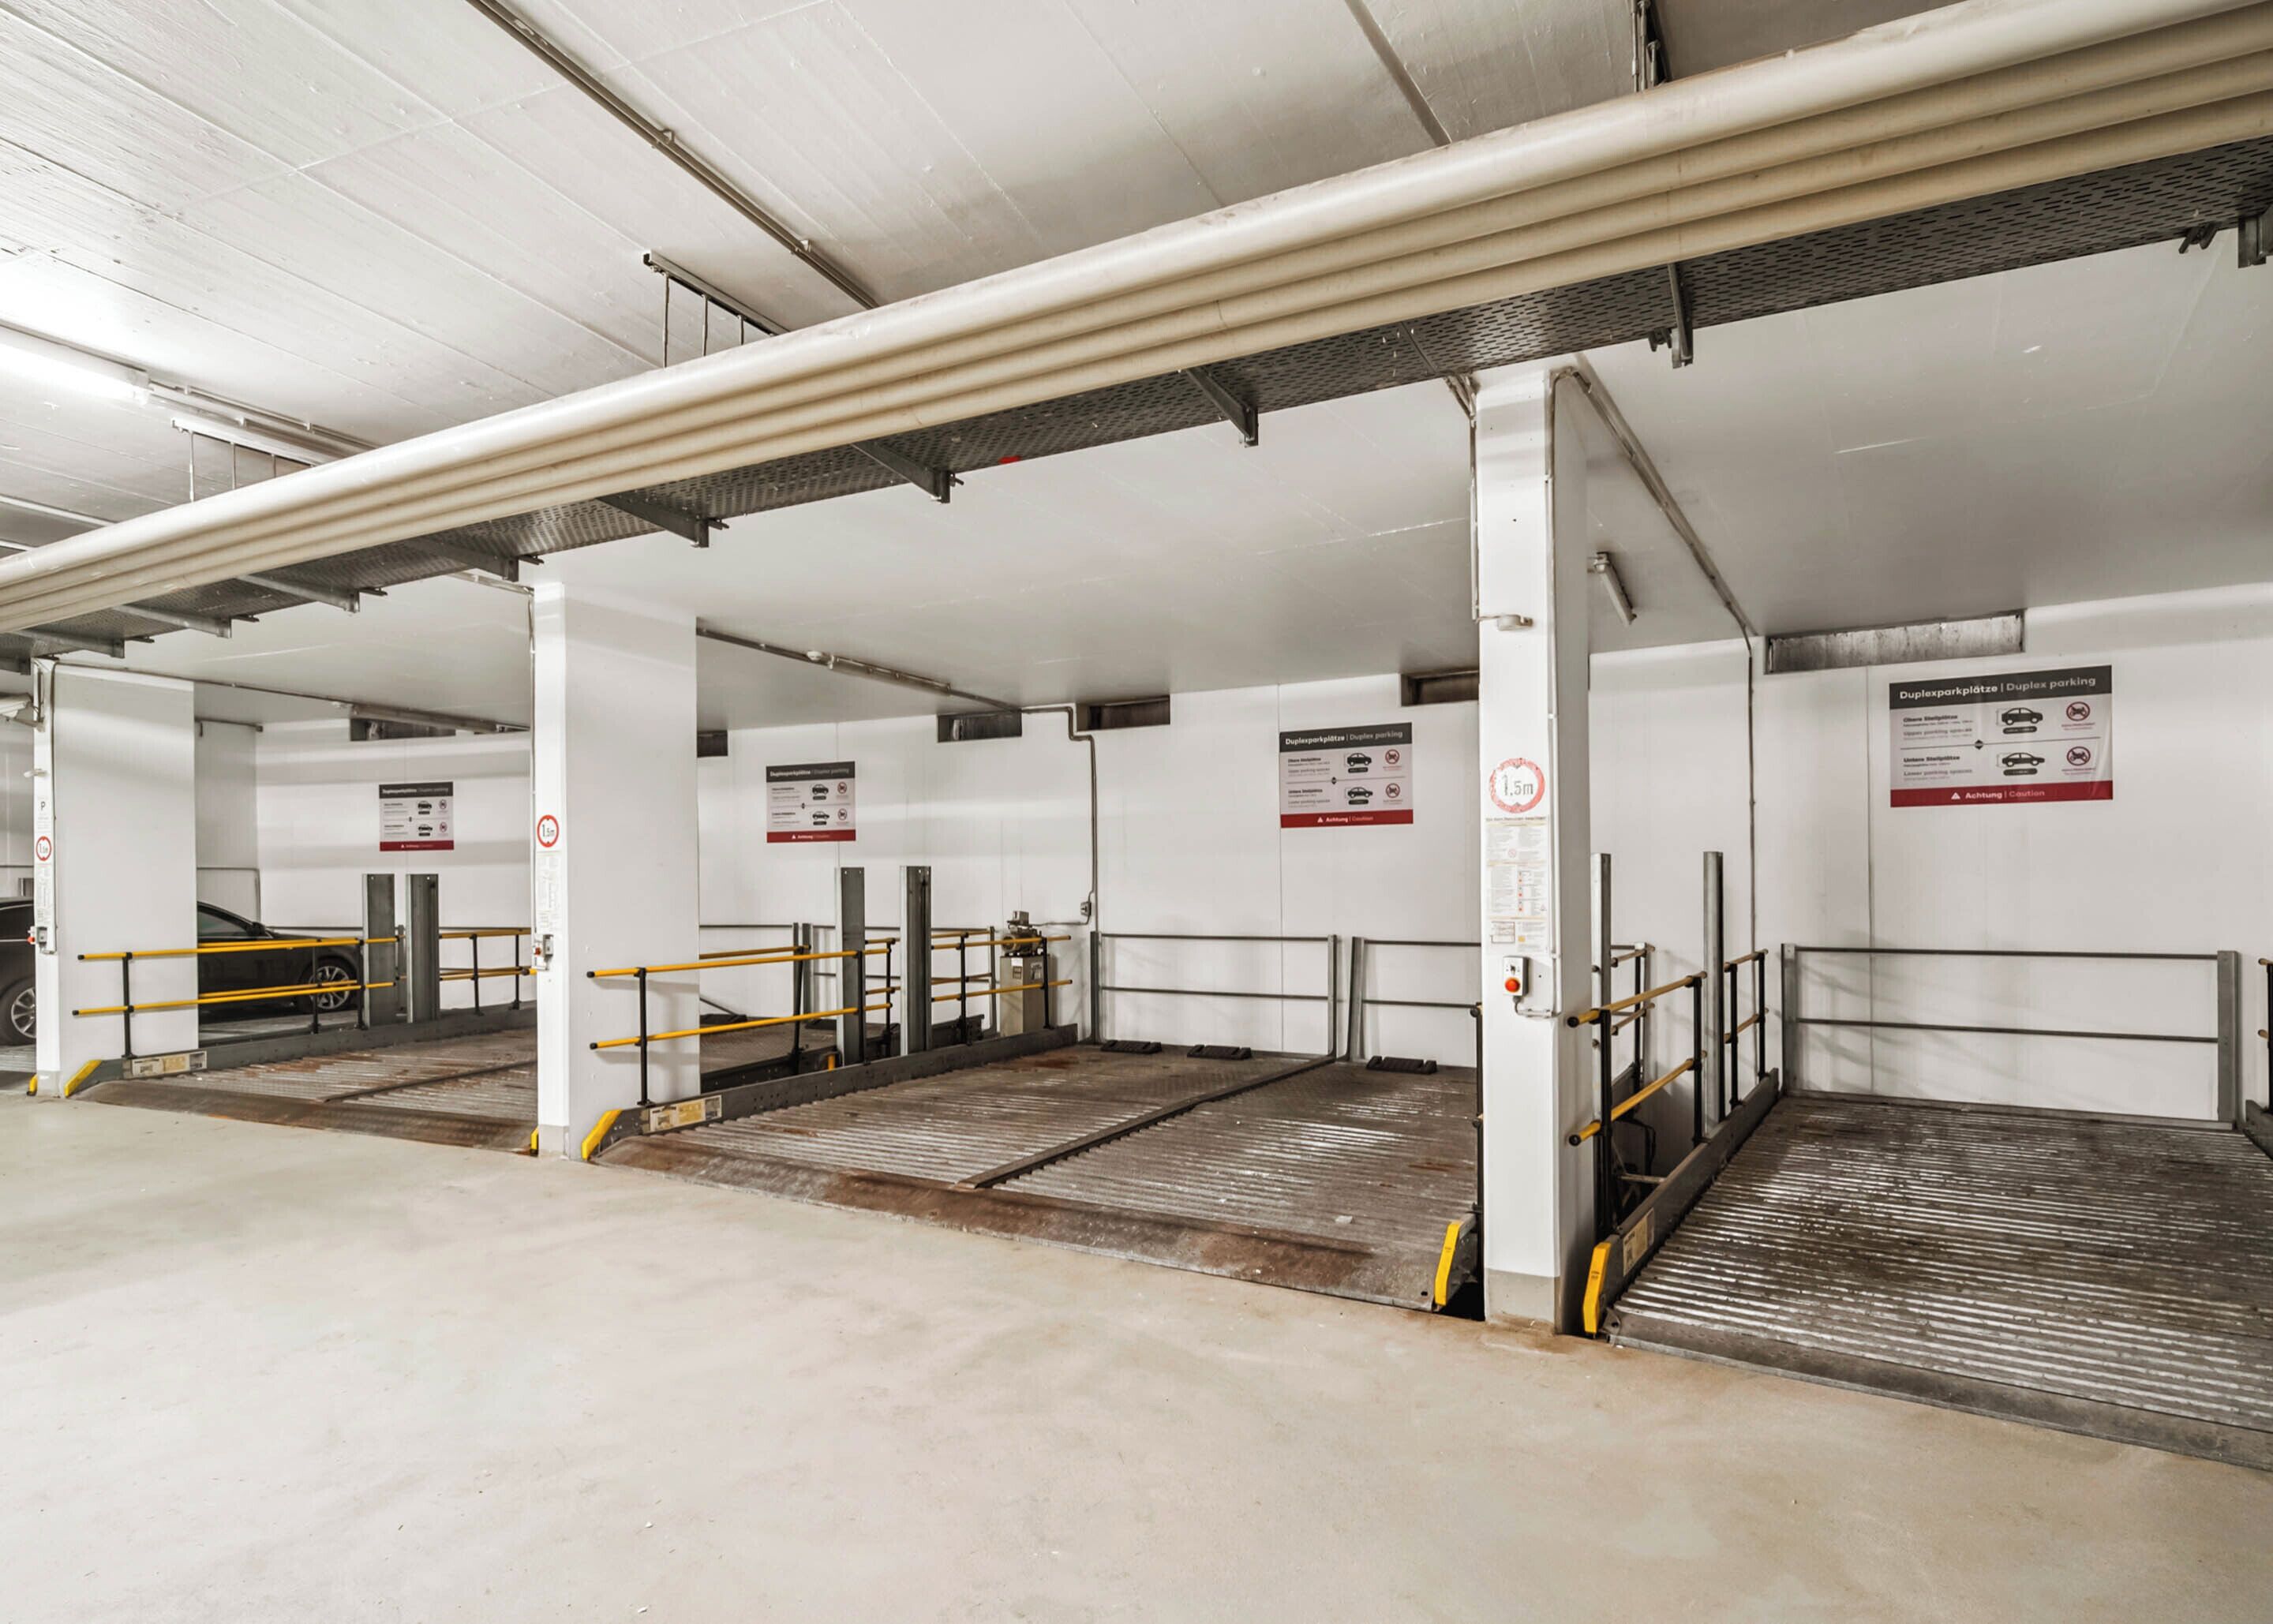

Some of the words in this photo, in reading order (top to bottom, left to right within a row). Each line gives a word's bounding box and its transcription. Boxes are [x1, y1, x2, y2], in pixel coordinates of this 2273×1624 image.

[1900, 685, 1998, 700] Duplexparkplätze
[2006, 681, 2046, 692] Duplex
[2050, 677, 2096, 690] parking
